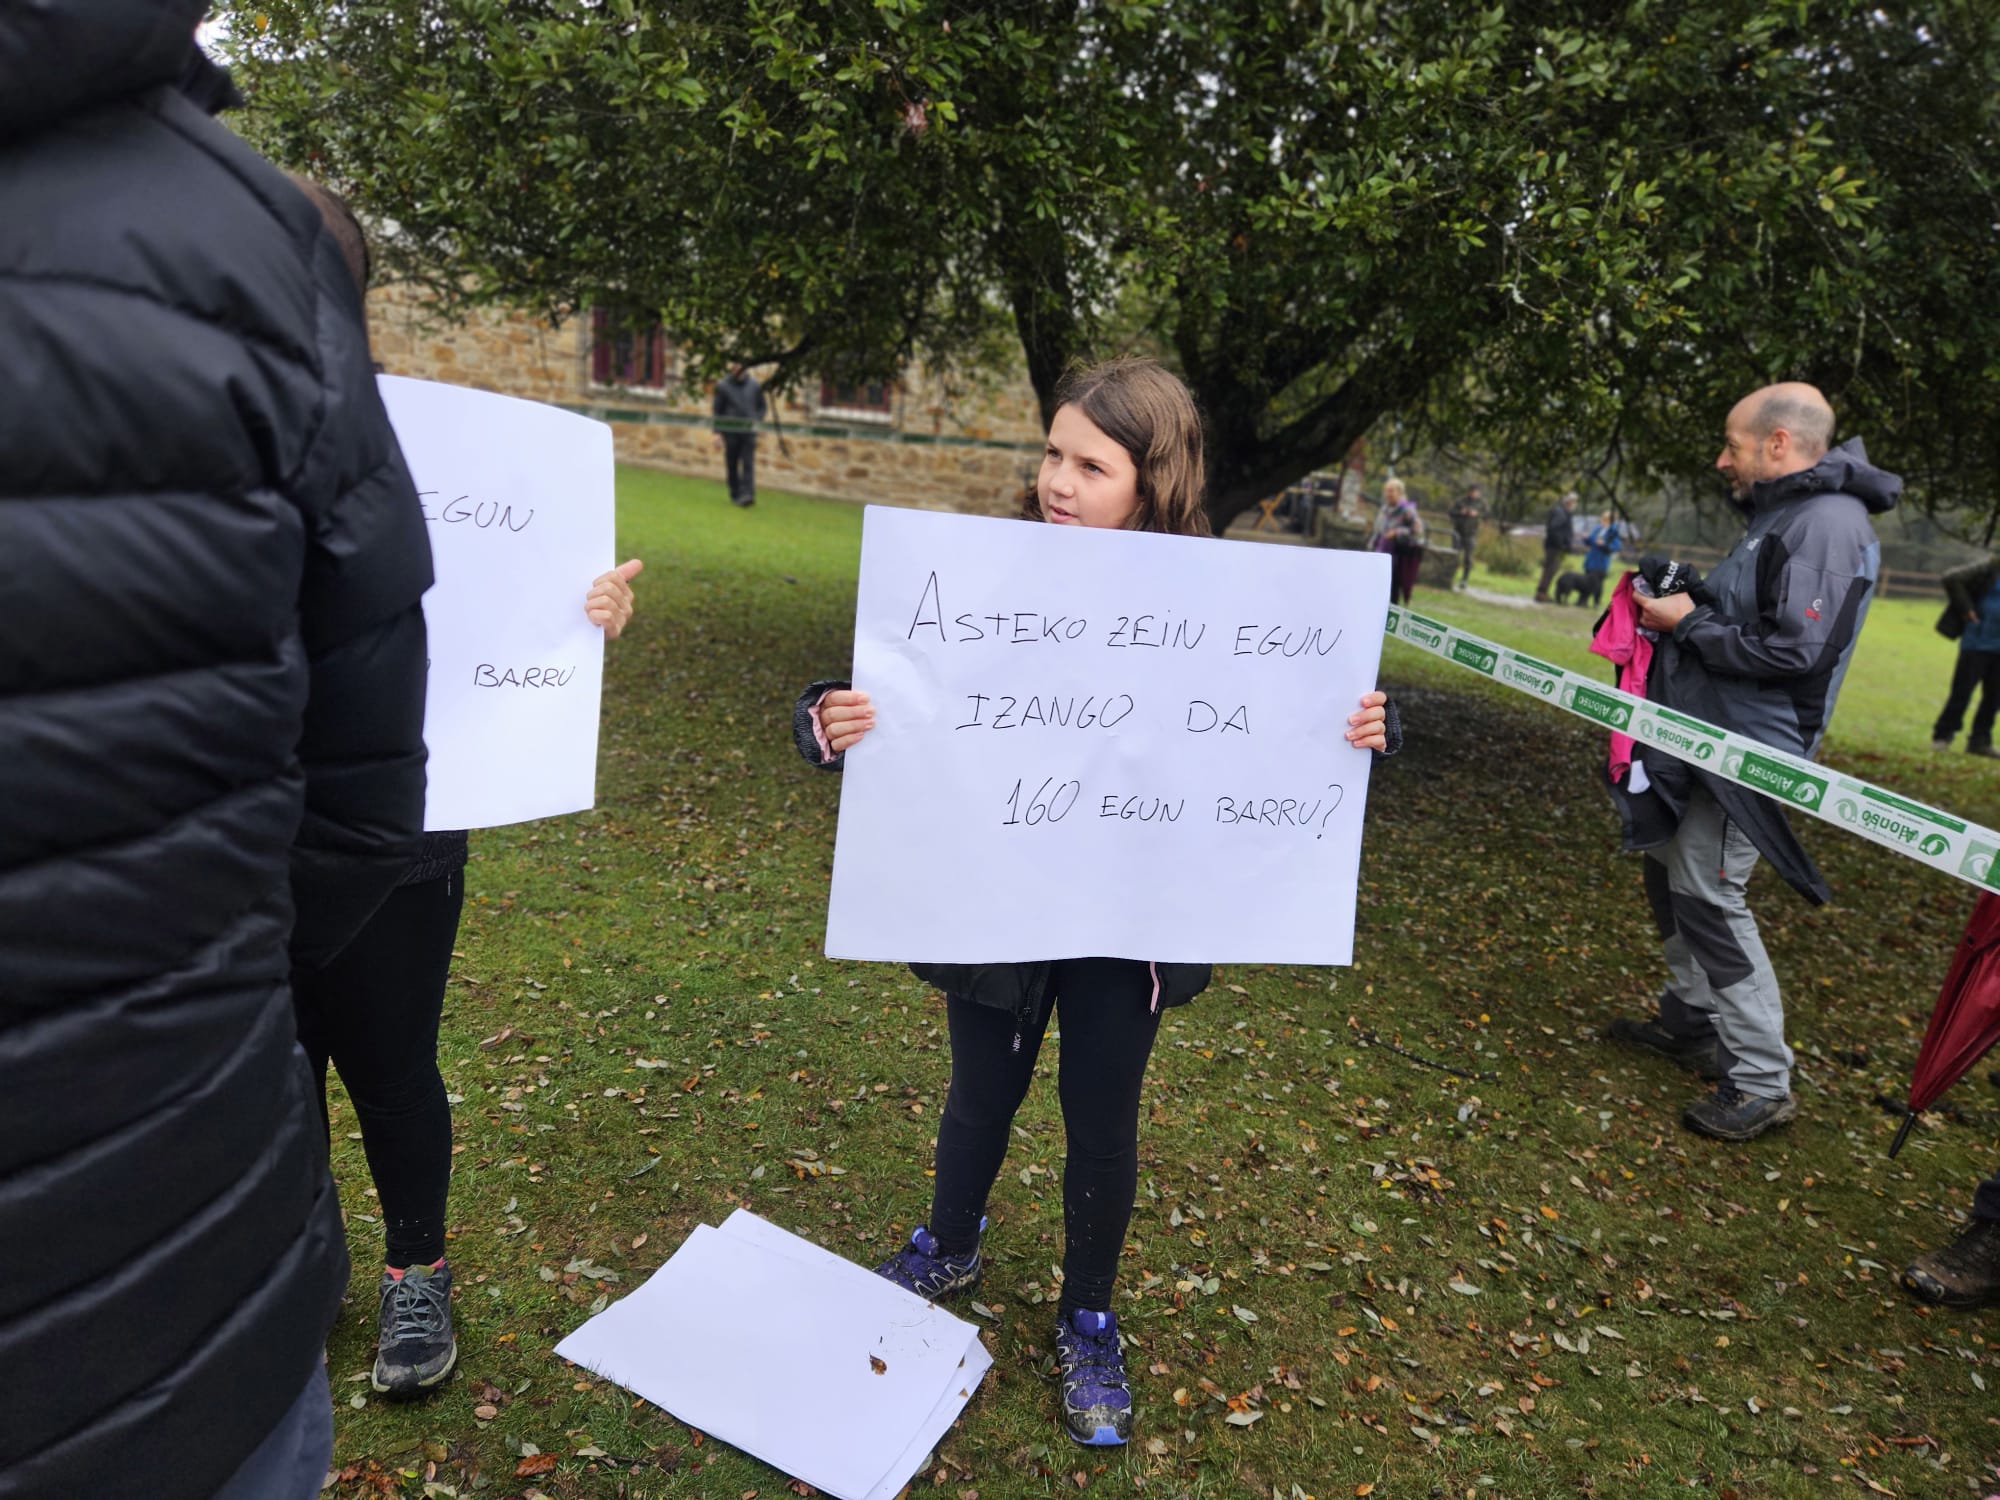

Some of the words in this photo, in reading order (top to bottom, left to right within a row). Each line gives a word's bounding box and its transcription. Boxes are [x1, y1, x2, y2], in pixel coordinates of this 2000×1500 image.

[907, 571, 1087, 643] ASTEKO
[1234, 625, 1343, 658] EGUN
[473, 663, 577, 689] BARRU
[954, 693, 1134, 731] IZANGO
[1186, 700, 1251, 735] DA
[1747, 764, 1793, 792] Alonso
[1002, 777, 1081, 826] 160
[1098, 795, 1185, 823] EGUN
[1216, 784, 1344, 840] BARRU?
[1861, 809, 1919, 843] Alonso
